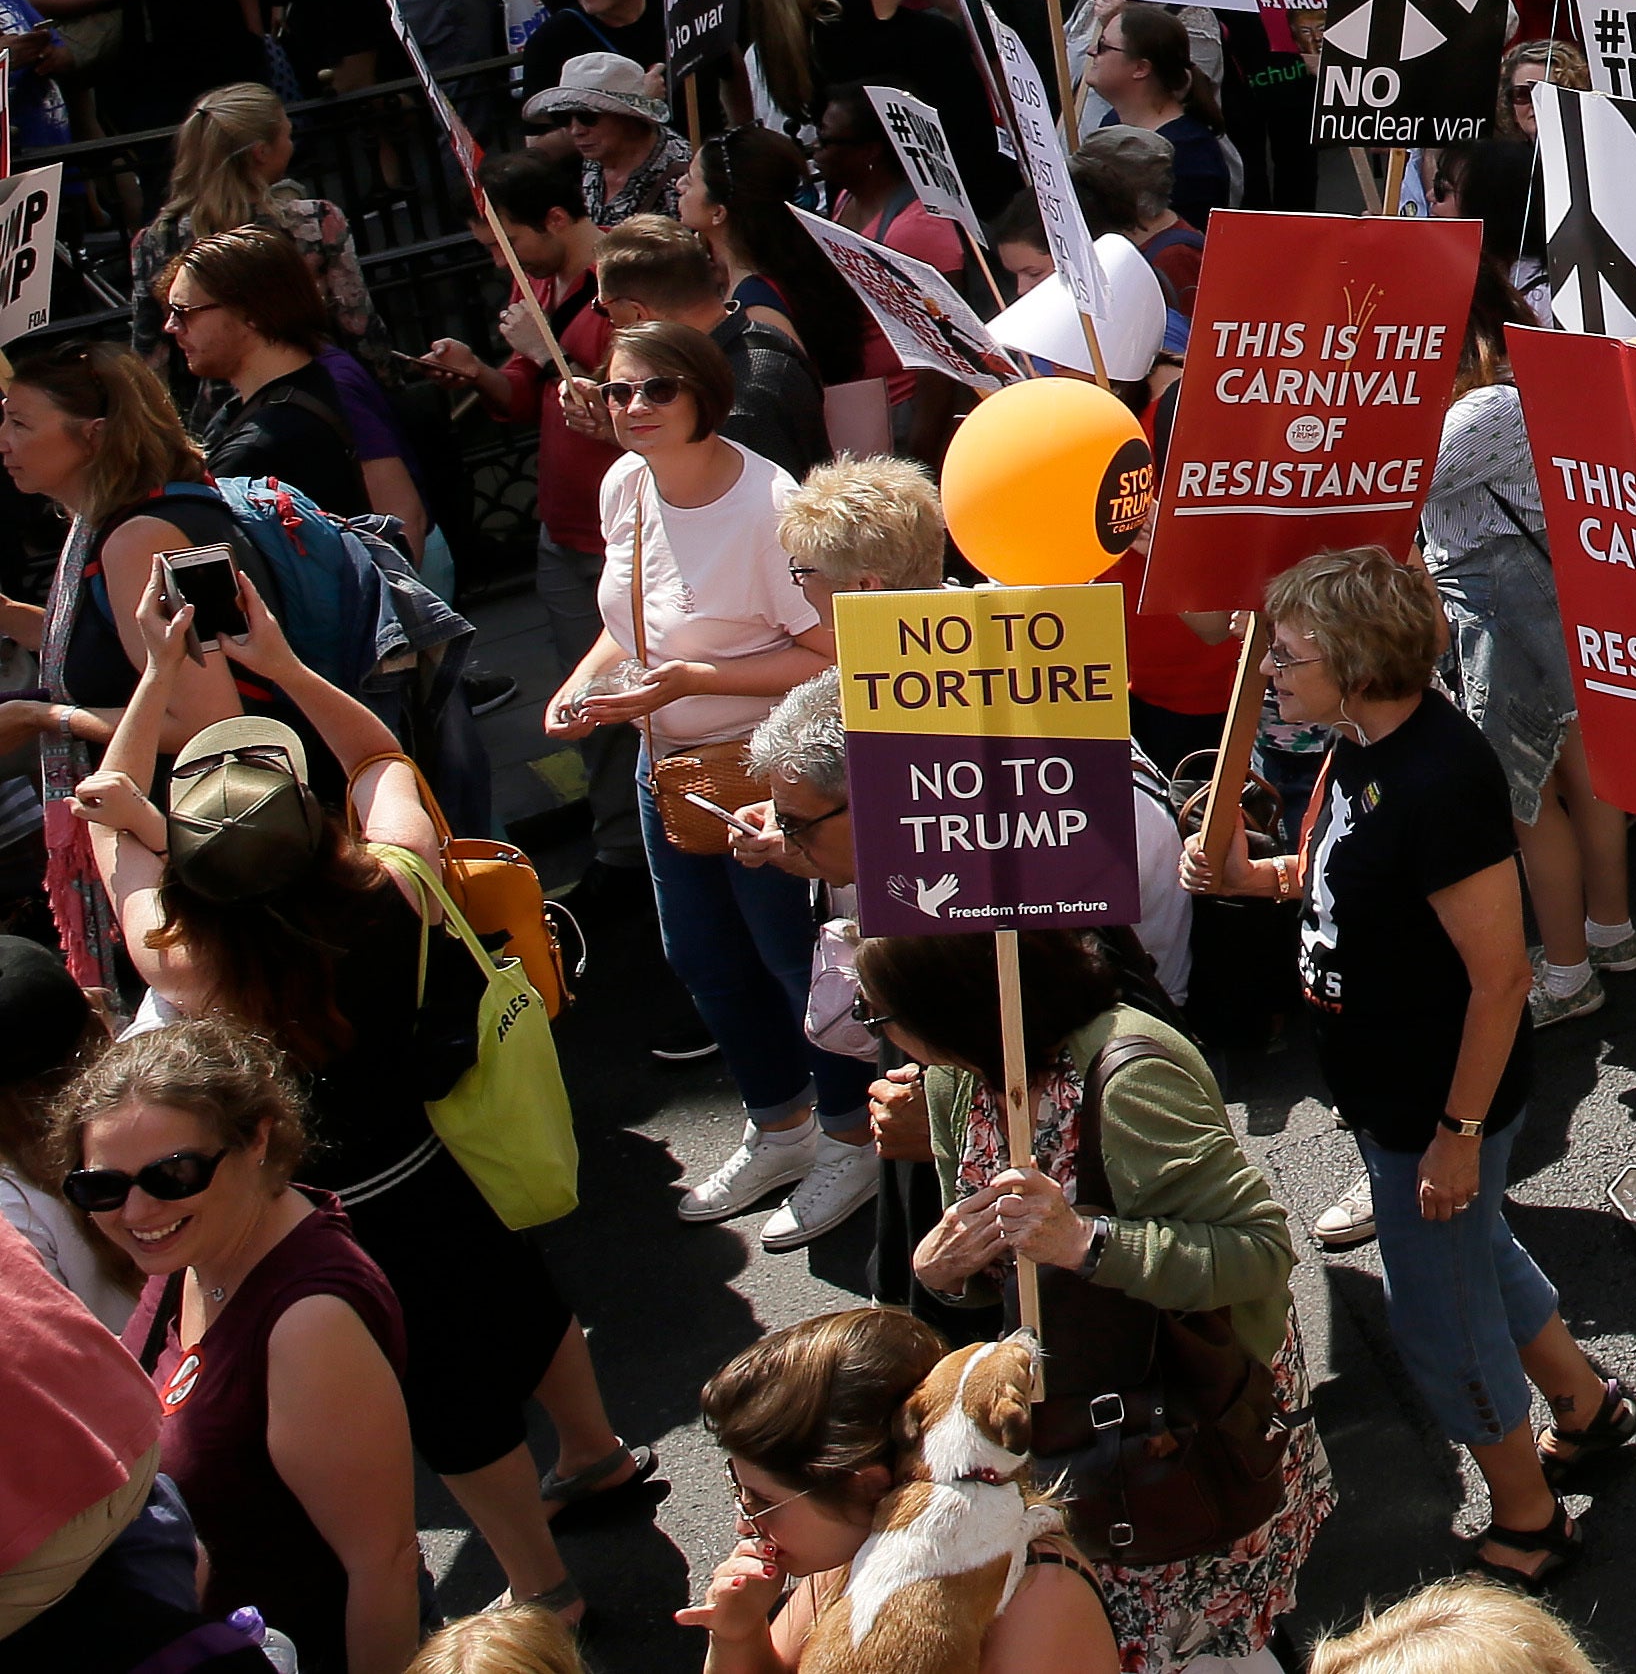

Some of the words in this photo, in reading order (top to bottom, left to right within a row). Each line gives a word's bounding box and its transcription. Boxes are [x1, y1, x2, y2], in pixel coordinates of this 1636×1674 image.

[1323, 66, 1400, 107] NO
[1319, 112, 1423, 142] nuclear
[1432, 116, 1485, 142] war
[1212, 321, 1305, 358] THIS
[1321, 325, 1357, 360] IS
[1373, 325, 1446, 360] THE
[1216, 368, 1421, 406] CARNIVAL
[1177, 459, 1424, 498] RESISTANCE
[898, 615, 972, 656] NO
[991, 611, 1065, 652] TO
[854, 663, 1113, 710] TORTURE
[909, 760, 984, 801] NO
[1002, 756, 1074, 796] TO
[900, 809, 1088, 853] TRUMP
[949, 904, 1014, 919] Freedom
[1018, 902, 1053, 915] from
[1056, 899, 1108, 913] Torture
